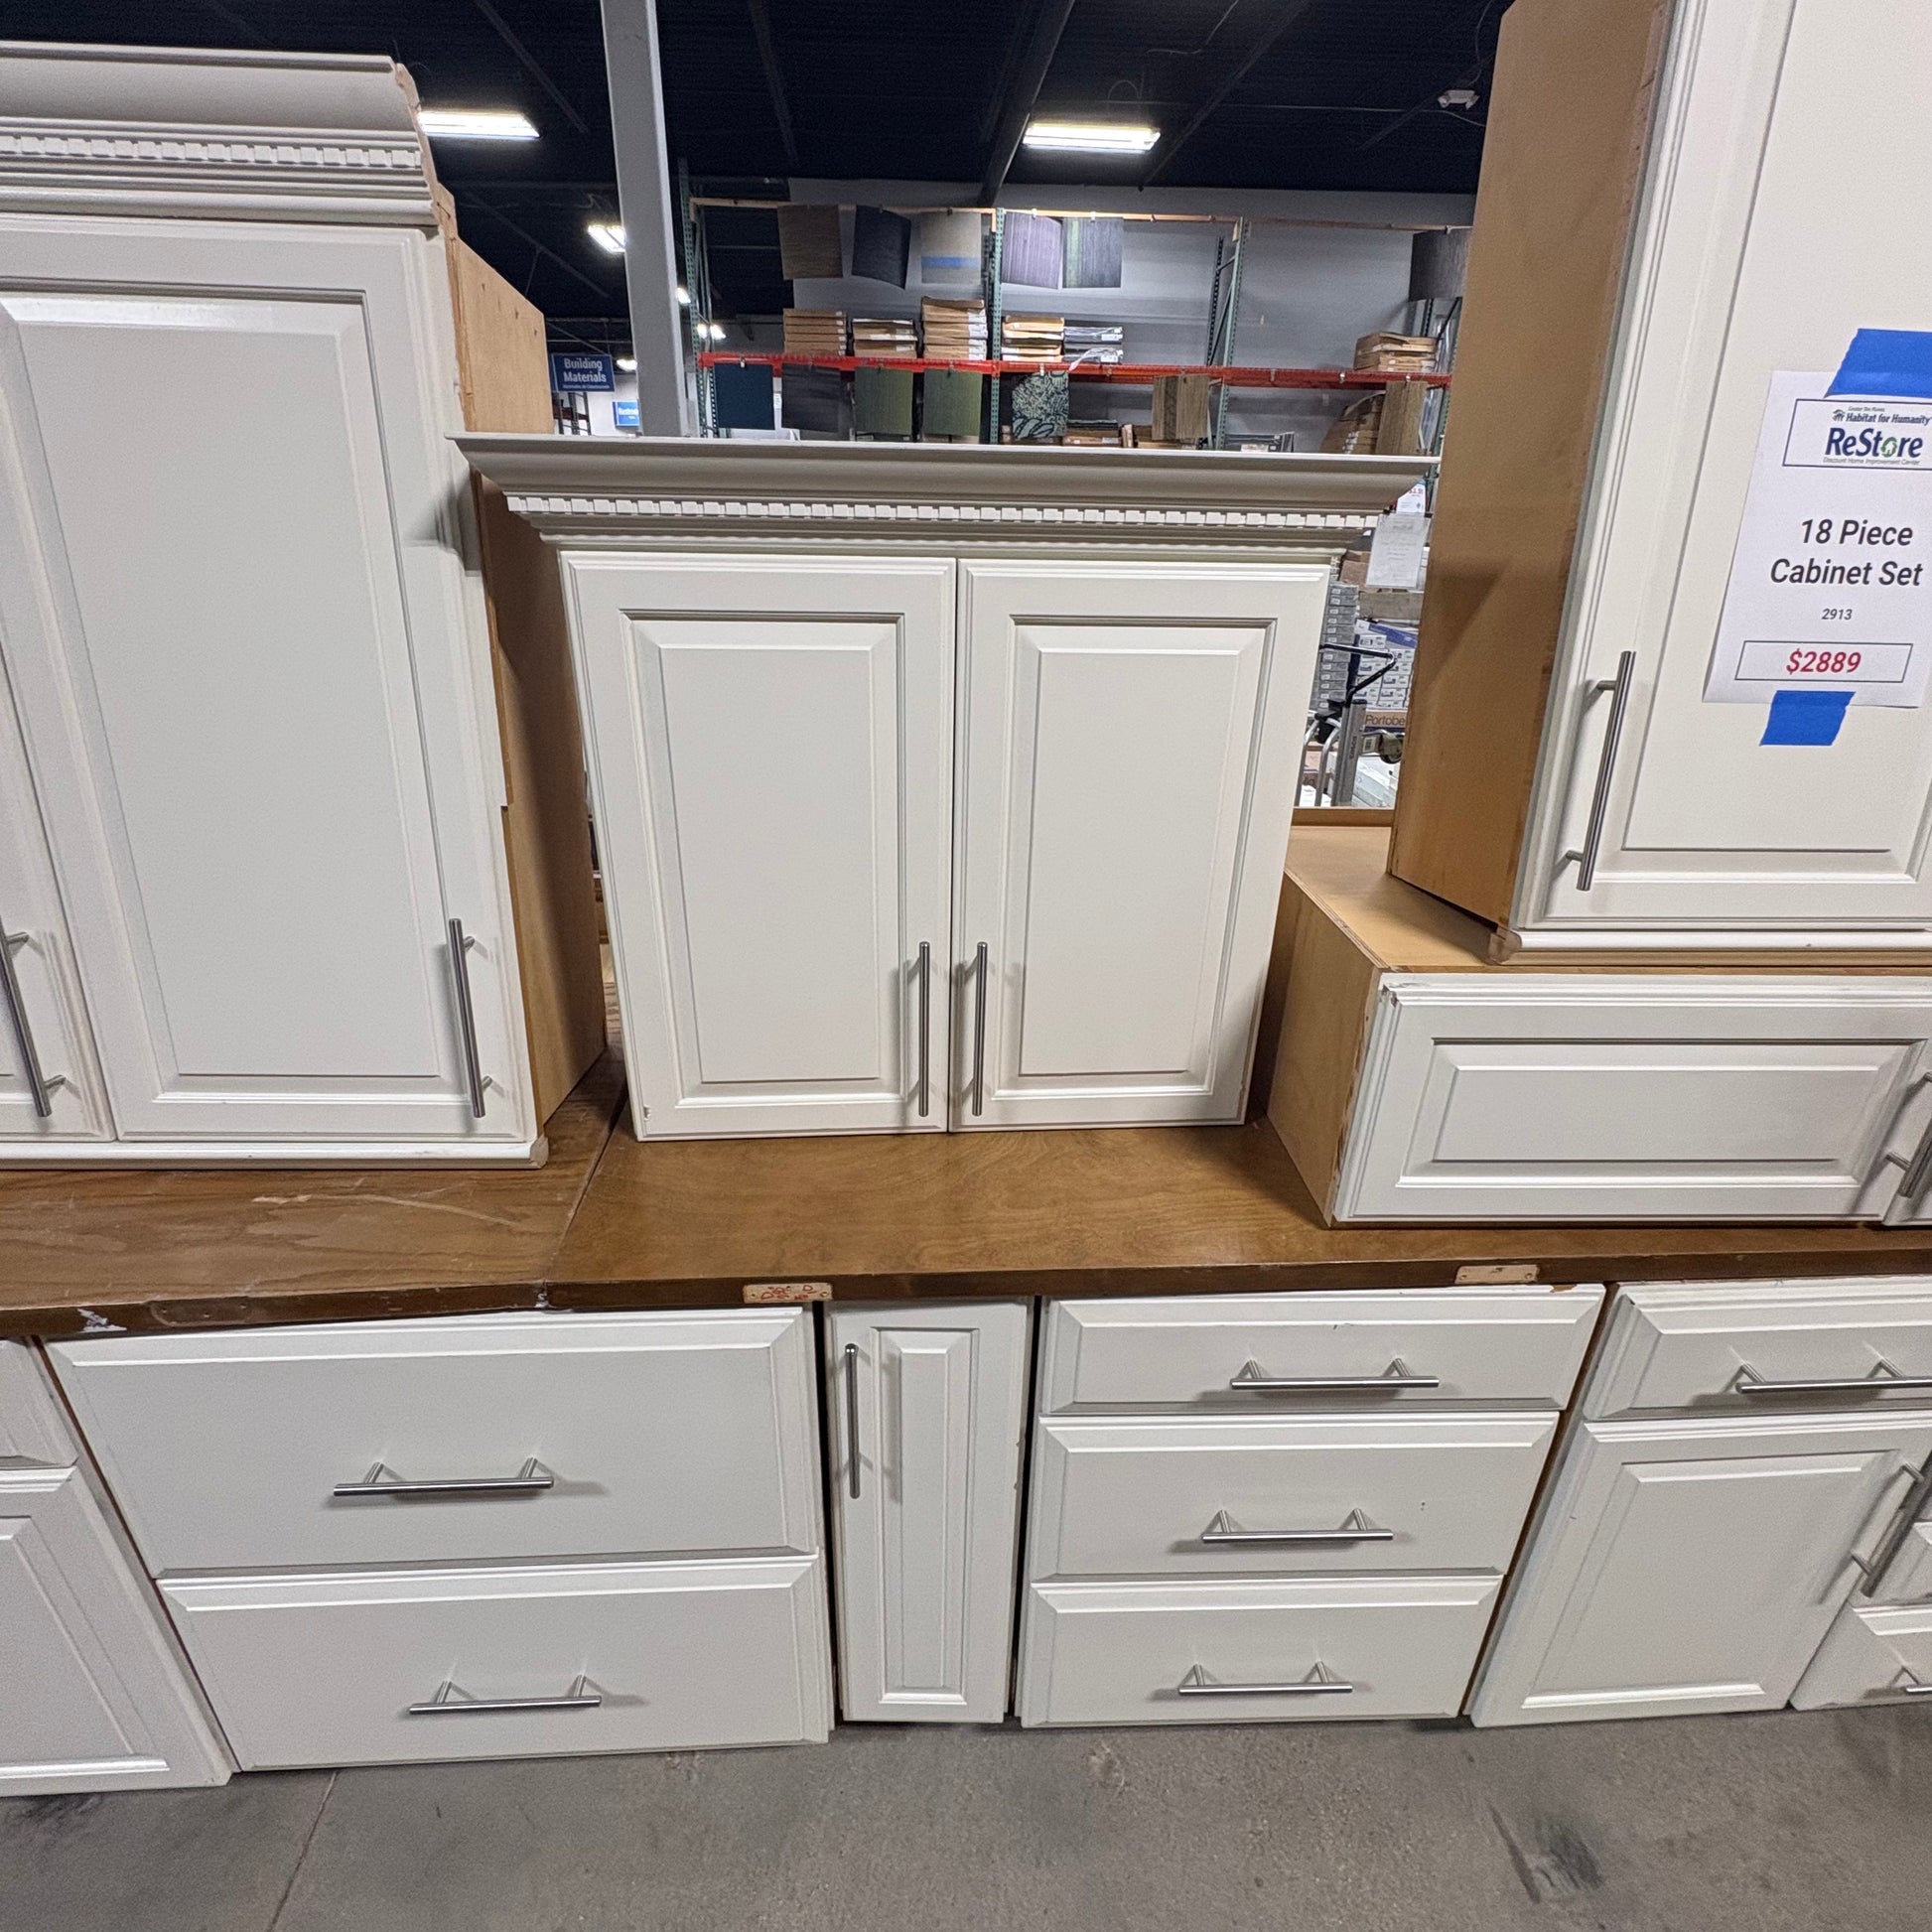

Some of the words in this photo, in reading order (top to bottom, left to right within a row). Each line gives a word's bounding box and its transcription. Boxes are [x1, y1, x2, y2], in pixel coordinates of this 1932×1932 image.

[564, 357, 603, 371] Building
[563, 371, 607, 382] Materials
[1846, 413, 1875, 423] Habitat
[1877, 414, 1891, 423] for
[1891, 414, 1931, 426] Humanity
[1825, 427, 1923, 458] ReStore
[1801, 518, 1833, 544] 18
[1839, 519, 1913, 546] Piece
[1770, 558, 1872, 585] Cabinet
[1878, 560, 1923, 587] Set
[1821, 608, 1853, 621] 2913
[1786, 648, 1862, 675] $2889
